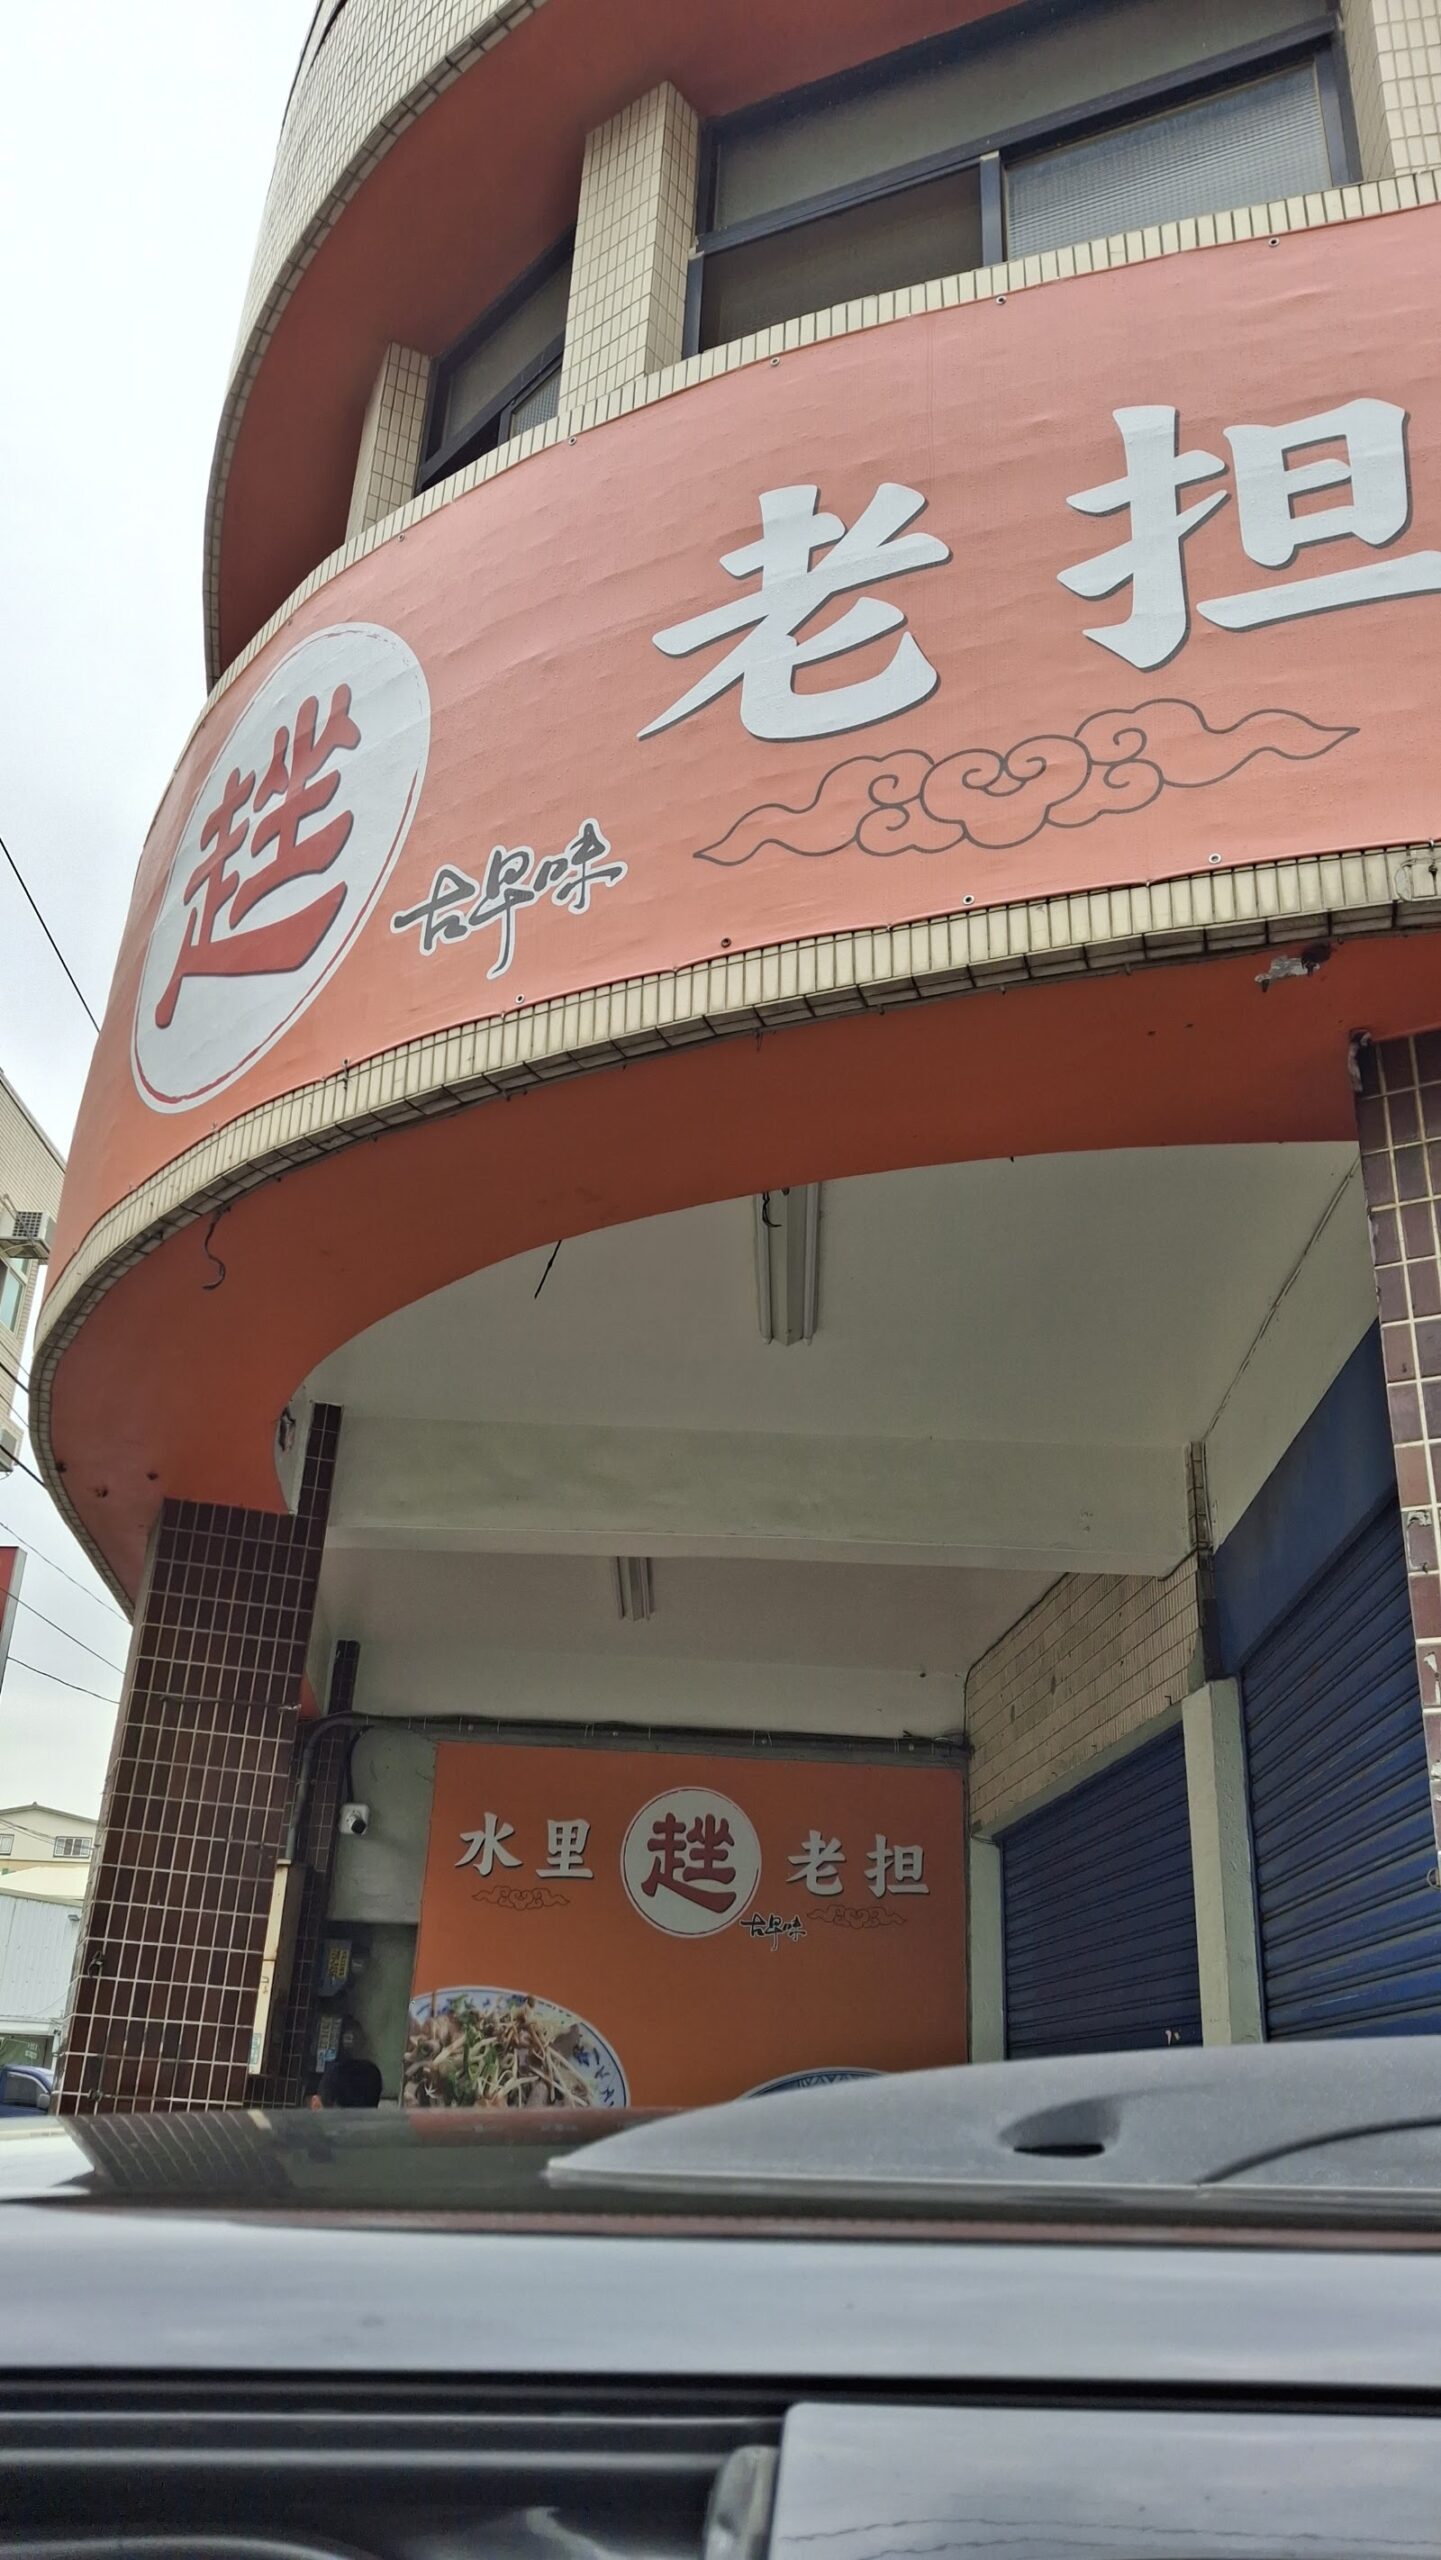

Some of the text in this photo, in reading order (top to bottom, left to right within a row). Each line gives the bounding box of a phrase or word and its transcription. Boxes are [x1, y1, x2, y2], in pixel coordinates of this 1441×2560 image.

[393, 819, 627, 979] 古早味
[455, 1812, 594, 1880] 水里
[786, 1829, 931, 1899] 老担
[740, 1913, 808, 1952] 古早味
